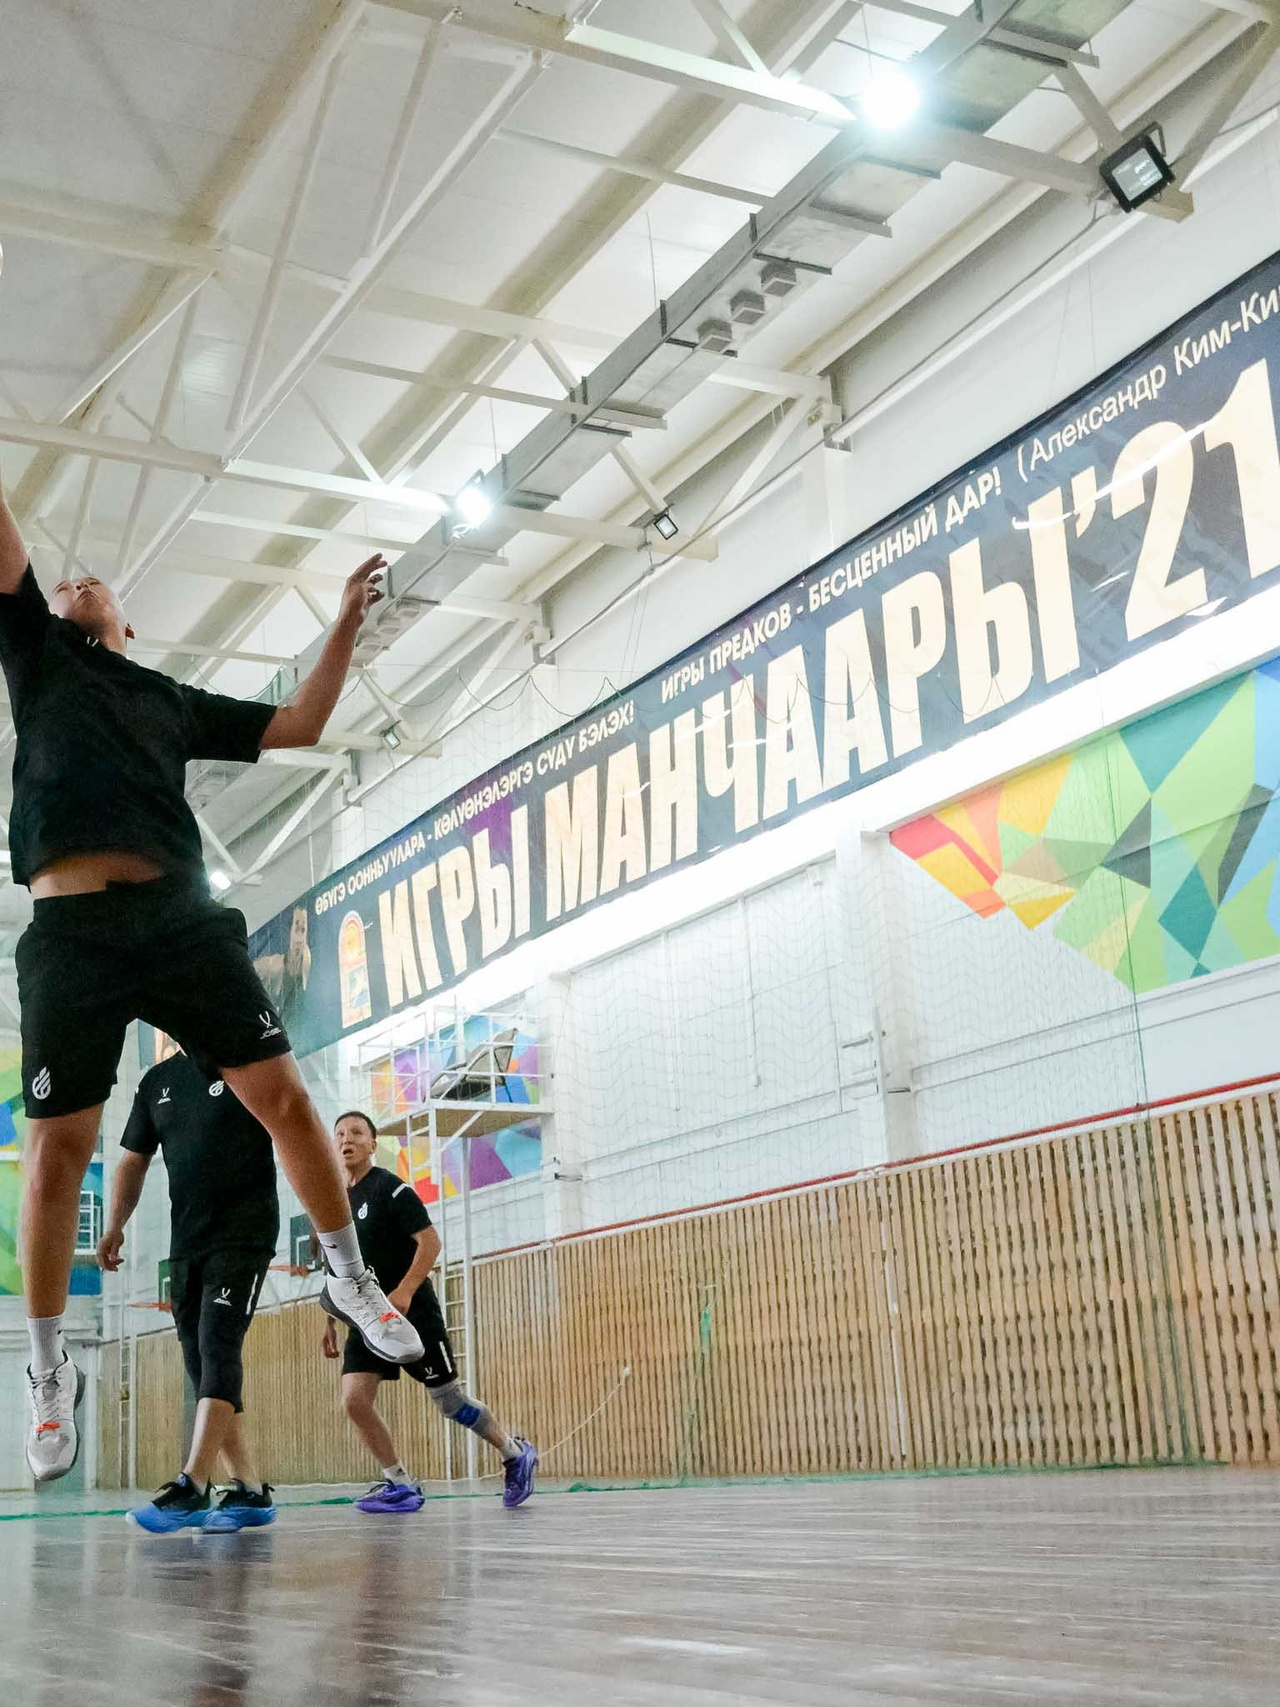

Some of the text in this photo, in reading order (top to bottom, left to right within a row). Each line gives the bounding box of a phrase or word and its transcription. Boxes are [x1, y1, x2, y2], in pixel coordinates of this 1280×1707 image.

[579, 701, 634, 752] БЭЛЭХ!
[661, 656, 705, 703] ИГРЫ
[709, 602, 792, 674] ПРЕДКОВ
[808, 503, 938, 613] БЕСЦЕННЫЙ
[945, 466, 1002, 533] ДАР!
[1017, 364, 1167, 483] (Александр
[1173, 285, 1280, 375] Ким-Ки
[377, 804, 532, 1008] ИГРЫ
